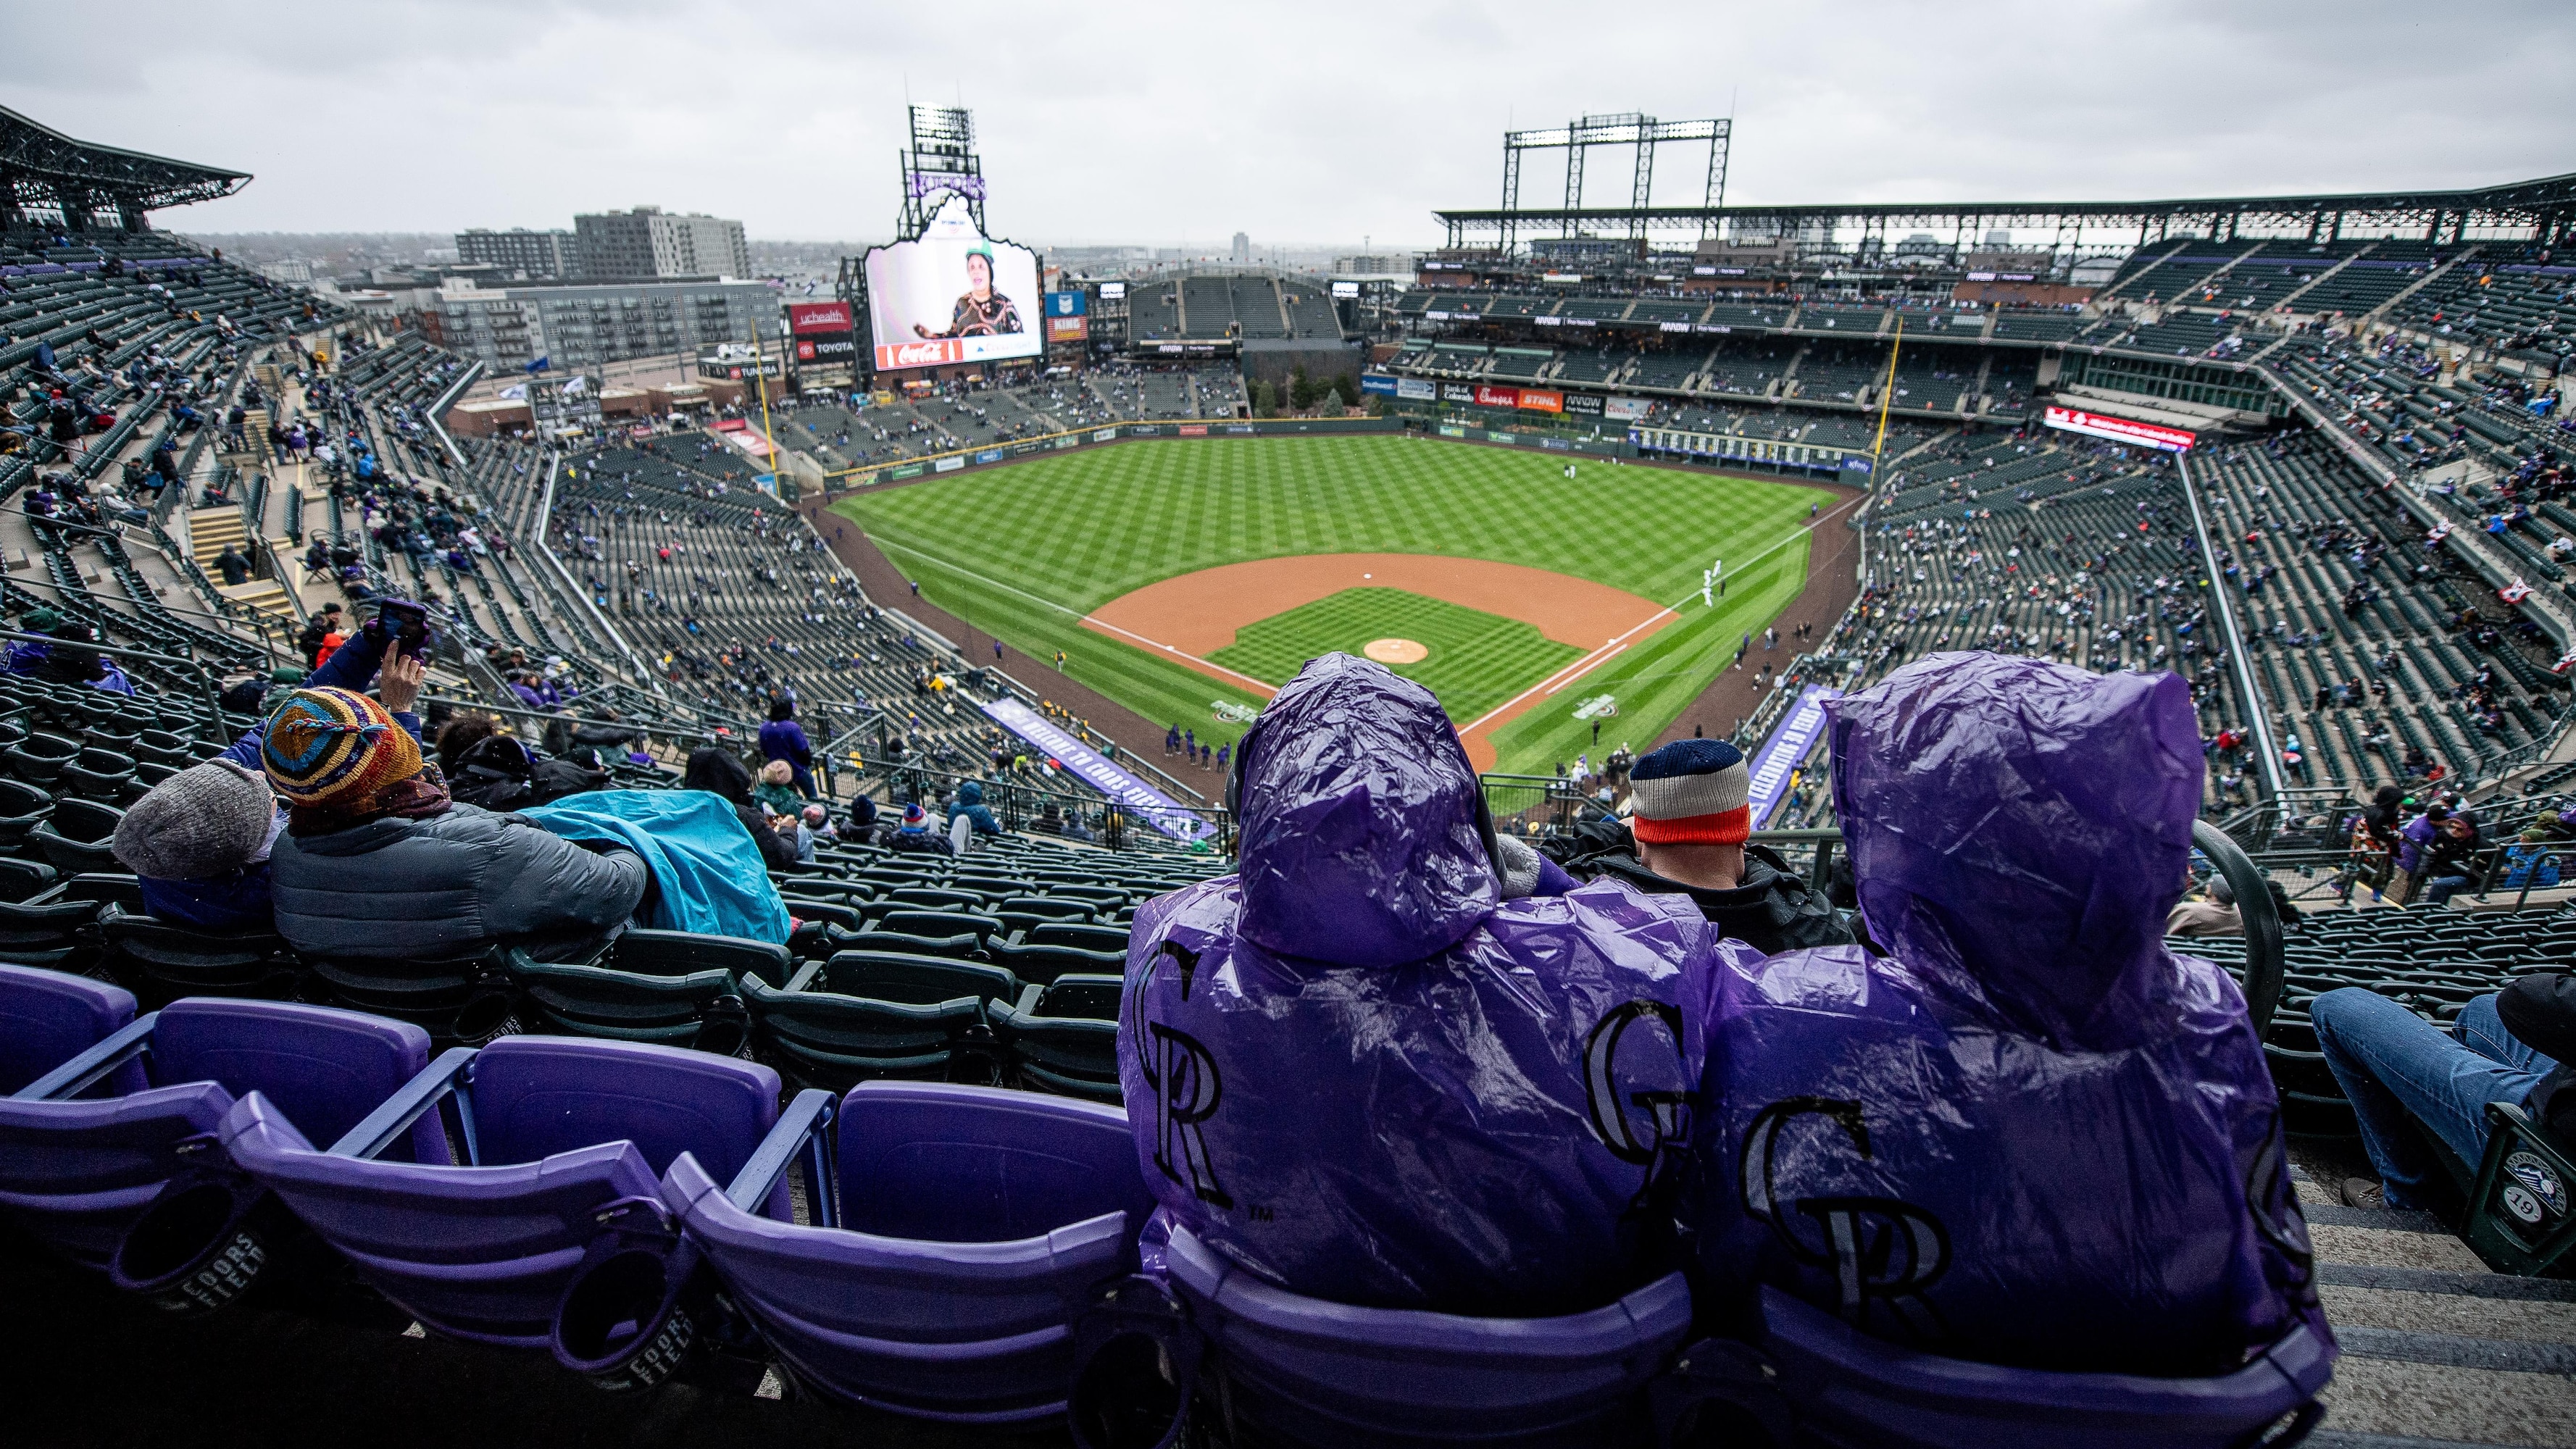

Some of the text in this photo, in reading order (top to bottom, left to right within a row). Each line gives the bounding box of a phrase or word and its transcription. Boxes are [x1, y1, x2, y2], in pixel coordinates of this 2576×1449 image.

[1836, 271, 1861, 280] Silver
[801, 309, 843, 324] uchealth
[1425, 312, 1449, 320] ARROW
[1535, 316, 1561, 326] ARROW
[1054, 318, 1080, 330] KING
[1659, 322, 1690, 333] ARROW
[817, 342, 854, 353] TOYOTA
[1362, 380, 1393, 390] Southwest
[1445, 384, 1460, 393] Bank
[1444, 392, 1474, 401] Colorado
[1525, 395, 1556, 406] STIHL
[1608, 404, 1630, 414] Coors
[1022, 722, 1077, 756] WELCOME
[1069, 751, 1094, 767] TO
[1085, 763, 1130, 790] COORS
[2510, 1193, 2534, 1215] 19
[183, 1233, 253, 1295] COORS
[198, 1245, 267, 1308] FIELD
[630, 1305, 687, 1375] COORS
